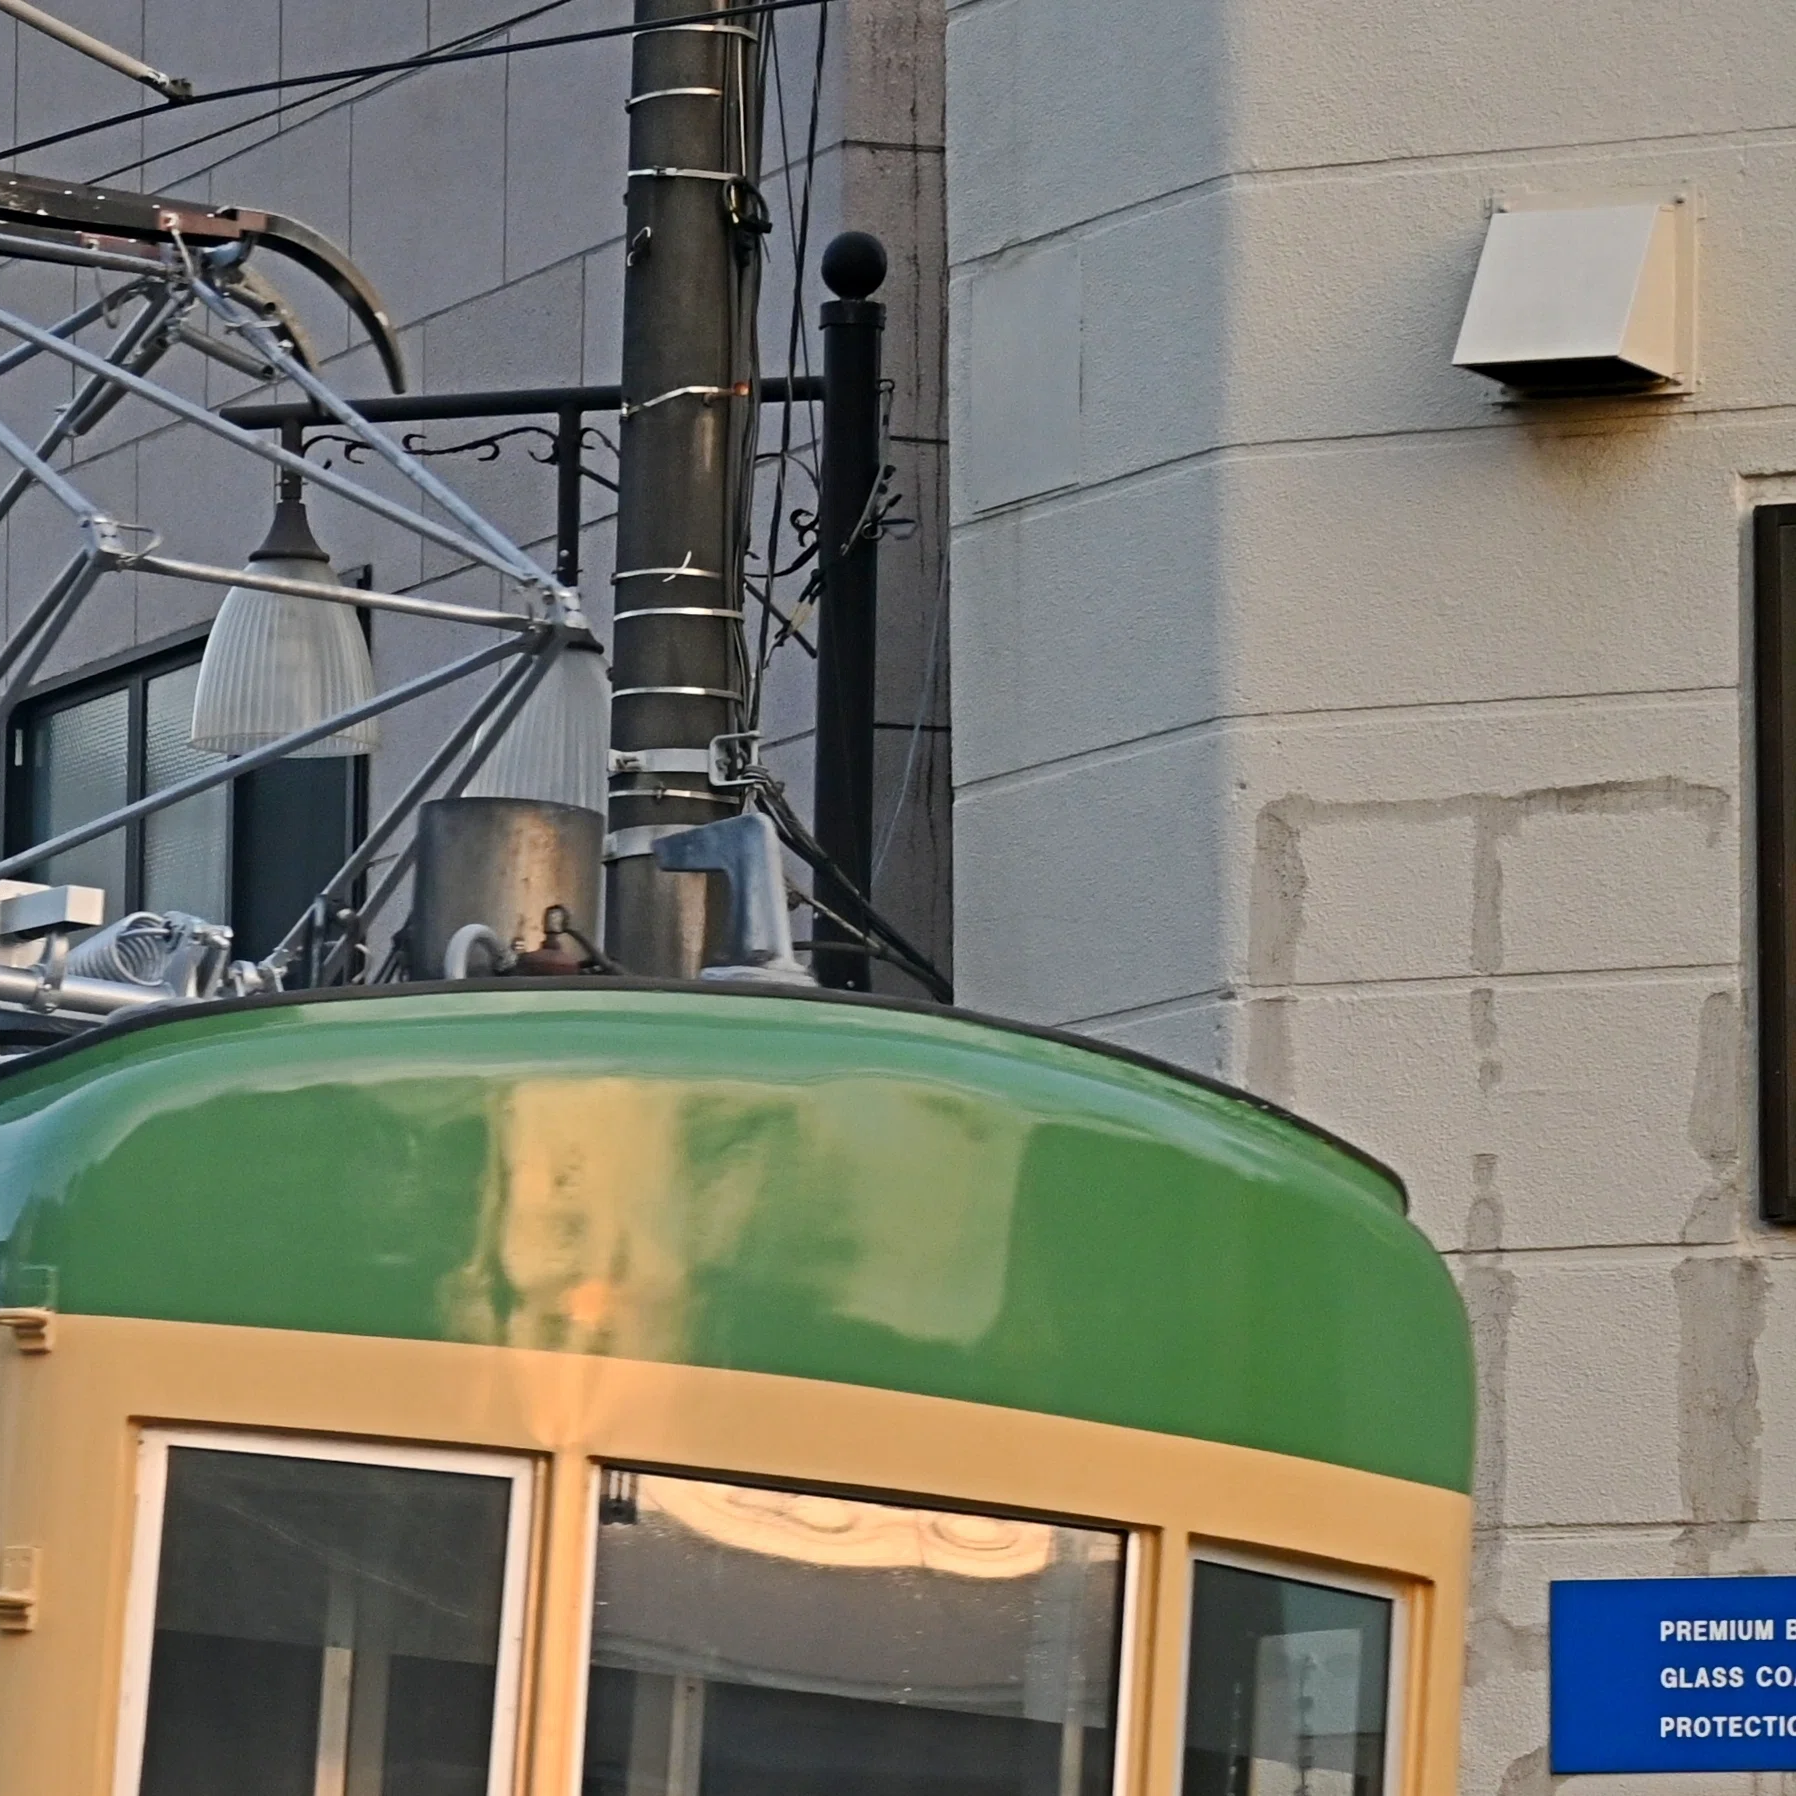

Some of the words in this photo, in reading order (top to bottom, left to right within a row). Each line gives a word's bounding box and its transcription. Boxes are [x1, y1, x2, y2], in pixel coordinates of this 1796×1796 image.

[1660, 1619, 1774, 1641] PREMIUM
[1660, 1666, 1744, 1688] GLASS
[1756, 1665, 1796, 1687] CO
